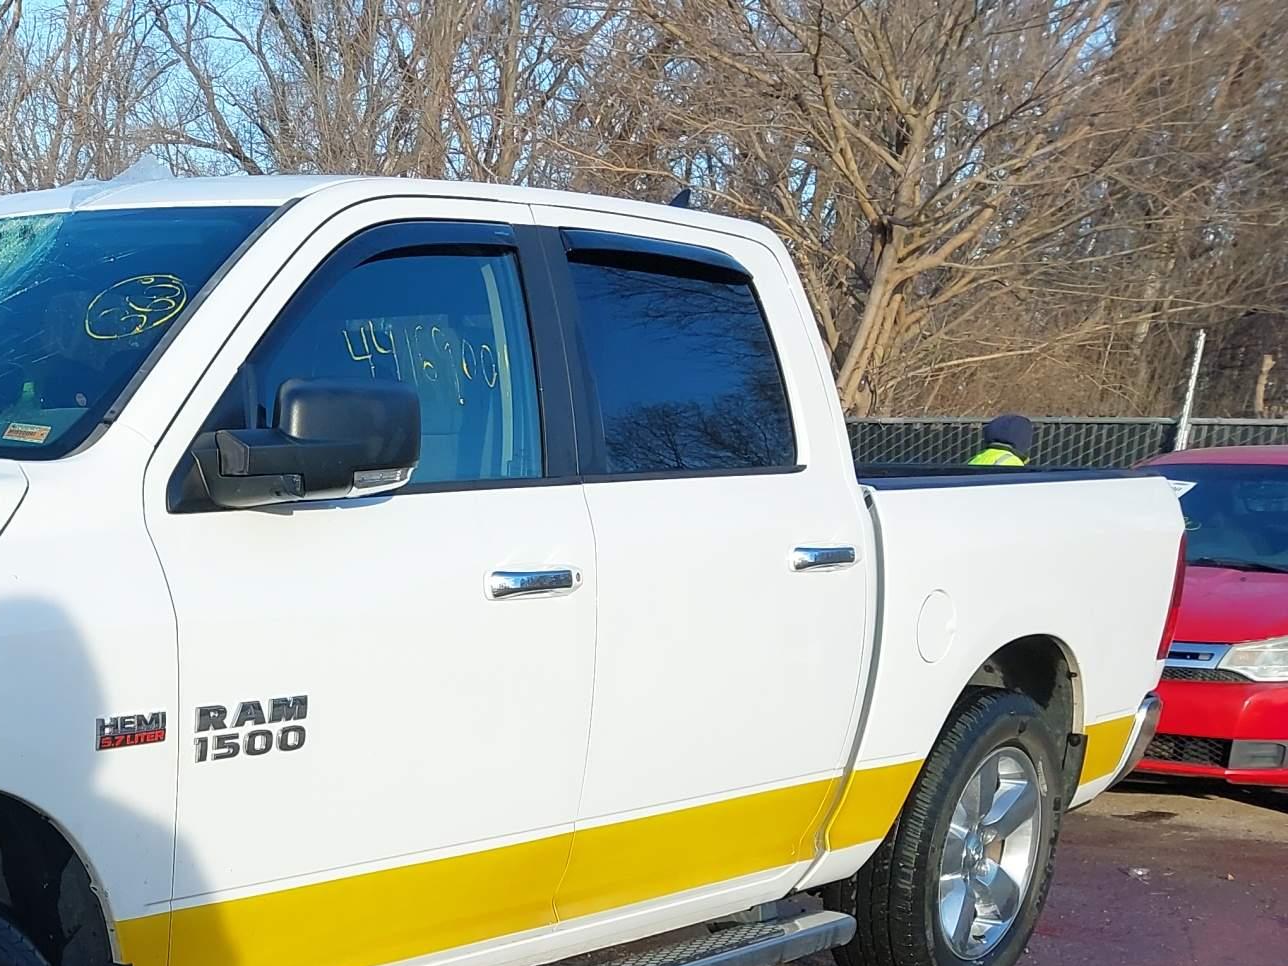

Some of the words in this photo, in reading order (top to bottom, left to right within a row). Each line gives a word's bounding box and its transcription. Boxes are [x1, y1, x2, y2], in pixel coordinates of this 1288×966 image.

[96, 711, 166, 737] HEMI
[194, 695, 308, 733] RAM
[101, 735, 124, 748] 5.7
[126, 729, 165, 745] LITER
[194, 725, 306, 763] 1500
